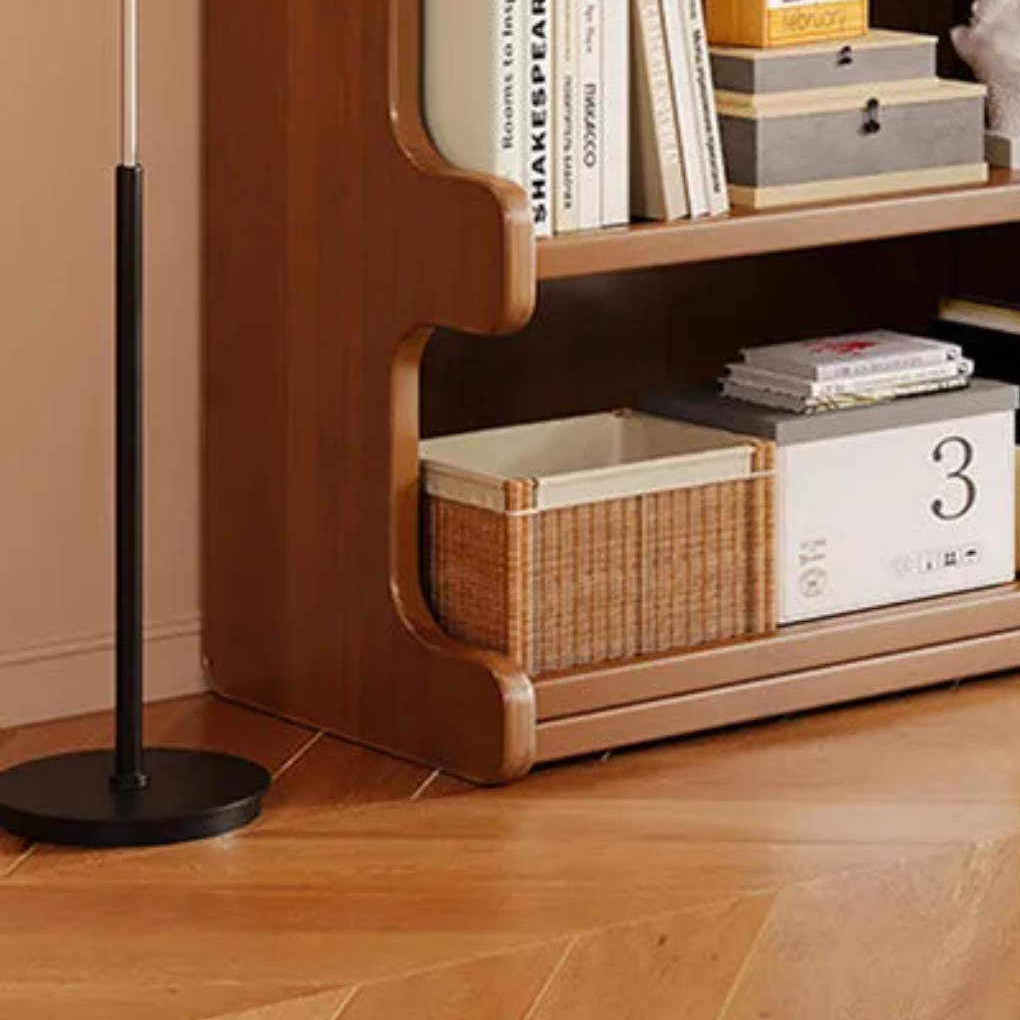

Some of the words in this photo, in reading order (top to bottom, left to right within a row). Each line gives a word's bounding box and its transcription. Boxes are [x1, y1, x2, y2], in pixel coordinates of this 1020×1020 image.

[502, 43, 513, 67] to
[502, 76, 514, 149] Rooms
[930, 435, 978, 520] 3
